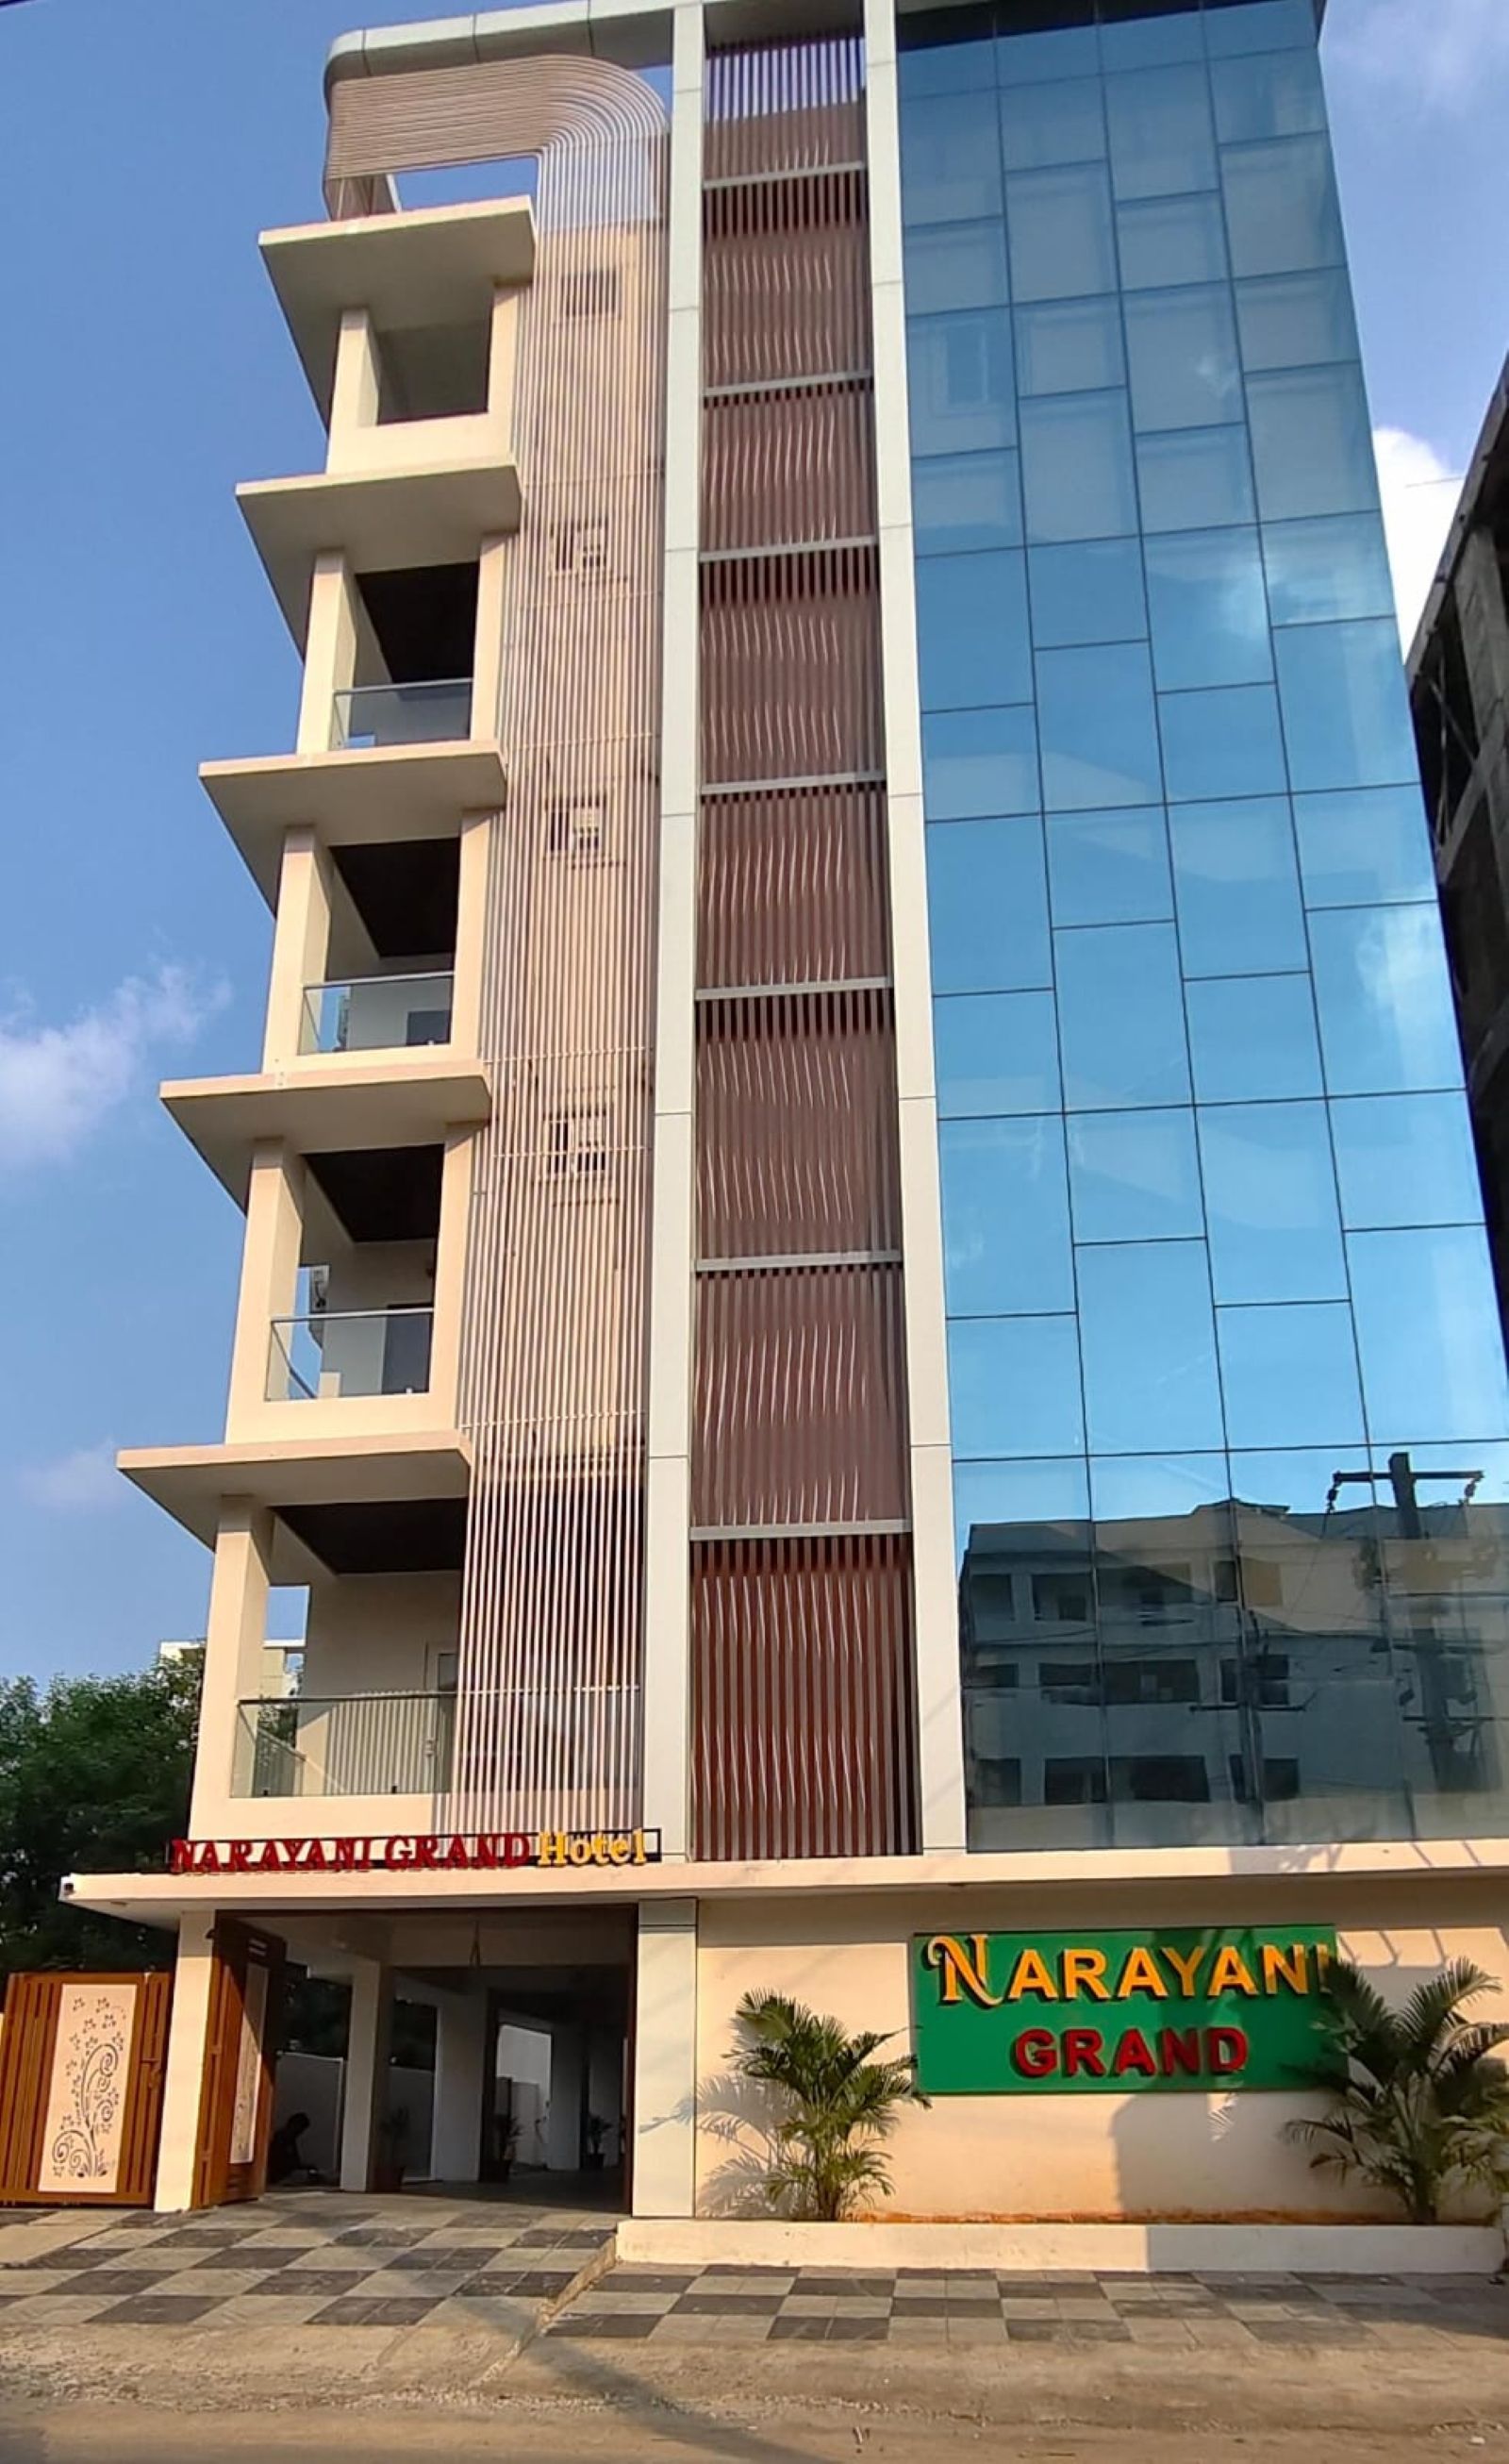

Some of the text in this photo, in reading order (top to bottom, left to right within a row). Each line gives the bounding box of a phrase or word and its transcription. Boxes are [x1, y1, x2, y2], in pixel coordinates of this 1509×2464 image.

[171, 1829, 647, 1873] NARAYANI GRAND Hotel
[927, 1934, 1331, 2006] NARAYANI
[1013, 2025, 1248, 2078] GRAND
